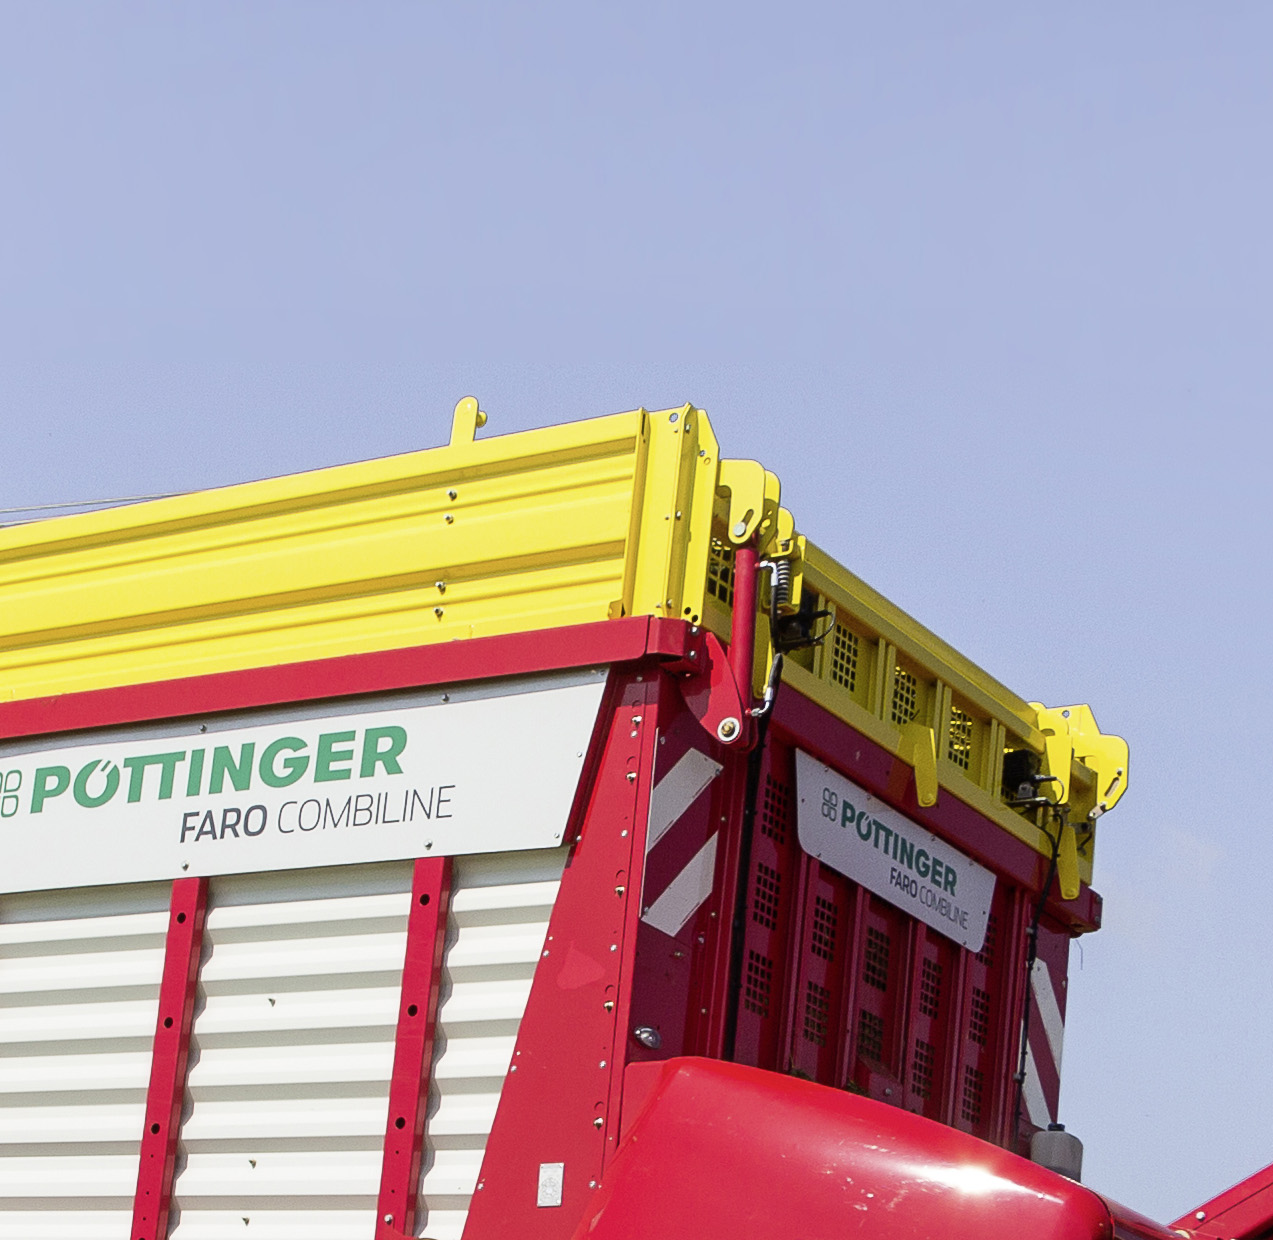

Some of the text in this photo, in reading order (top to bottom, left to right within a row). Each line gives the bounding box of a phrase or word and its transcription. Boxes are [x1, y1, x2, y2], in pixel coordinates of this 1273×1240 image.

[30, 725, 407, 814] PÖTTINGER
[179, 785, 456, 844] FARO COMBILINE
[889, 867, 968, 930] FARO COMBILINE
